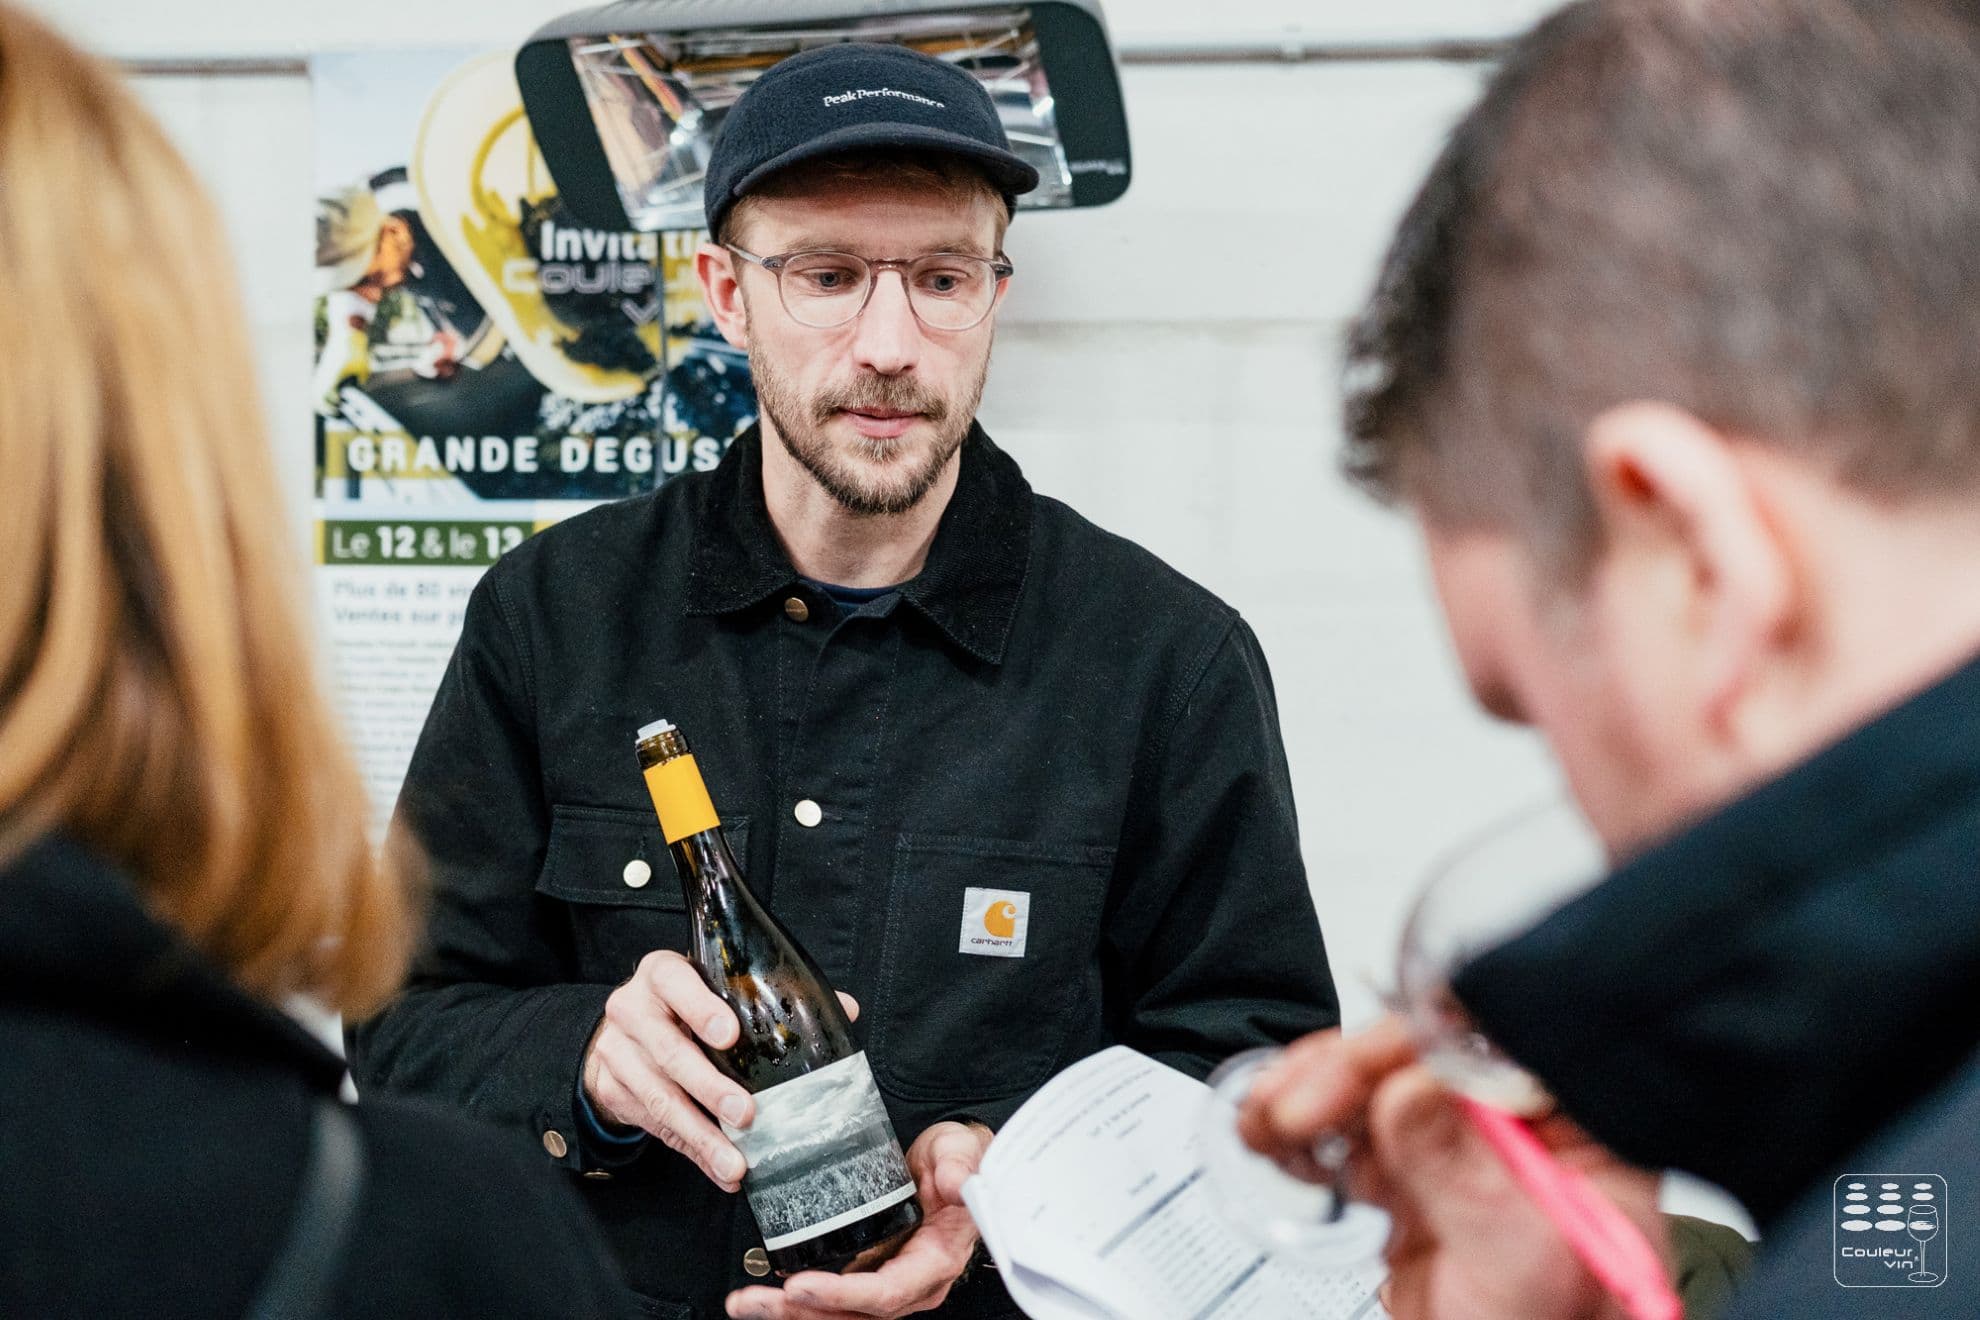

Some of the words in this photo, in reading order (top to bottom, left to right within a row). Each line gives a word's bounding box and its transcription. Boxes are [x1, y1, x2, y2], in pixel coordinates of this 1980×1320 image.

[348, 436, 538, 473] GRANDE
[560, 436, 735, 473] DEGUS
[332, 526, 371, 558] Le
[375, 525, 417, 559] 12
[421, 526, 445, 559] &
[449, 526, 477, 559] le
